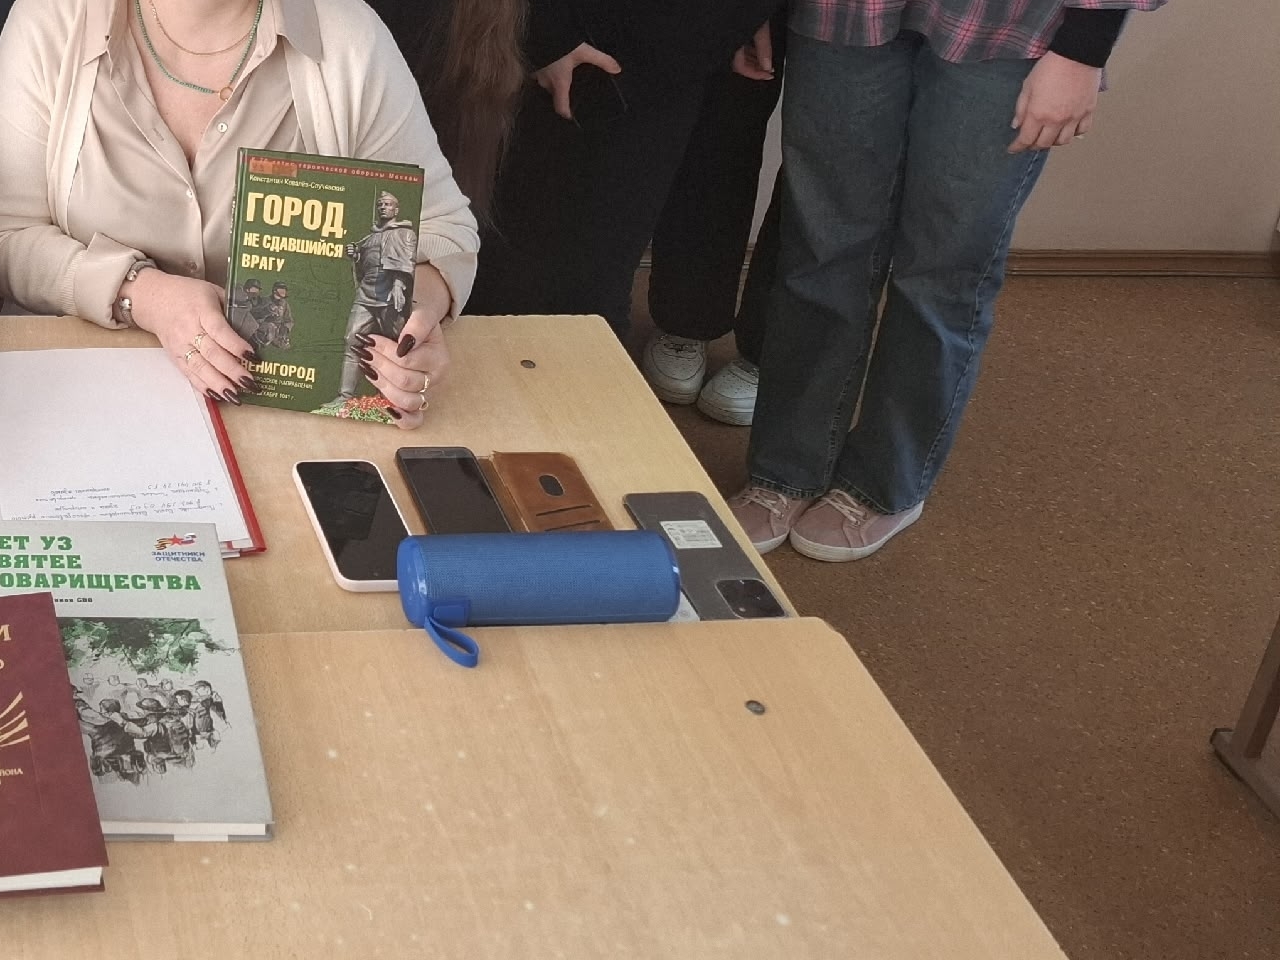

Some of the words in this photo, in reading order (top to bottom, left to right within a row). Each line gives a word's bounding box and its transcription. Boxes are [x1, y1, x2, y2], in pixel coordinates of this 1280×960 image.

[351, 170, 385, 178] обороны
[388, 172, 418, 182] Москвы
[246, 192, 348, 238] ГОРОД,
[243, 232, 260, 248] НЕ
[262, 234, 344, 258] СДАВШИЙСЯ
[241, 253, 285, 272] ВРАГУ
[241, 359, 316, 383] ВЕНИГОРОД
[39, 535, 73, 551] УЗ
